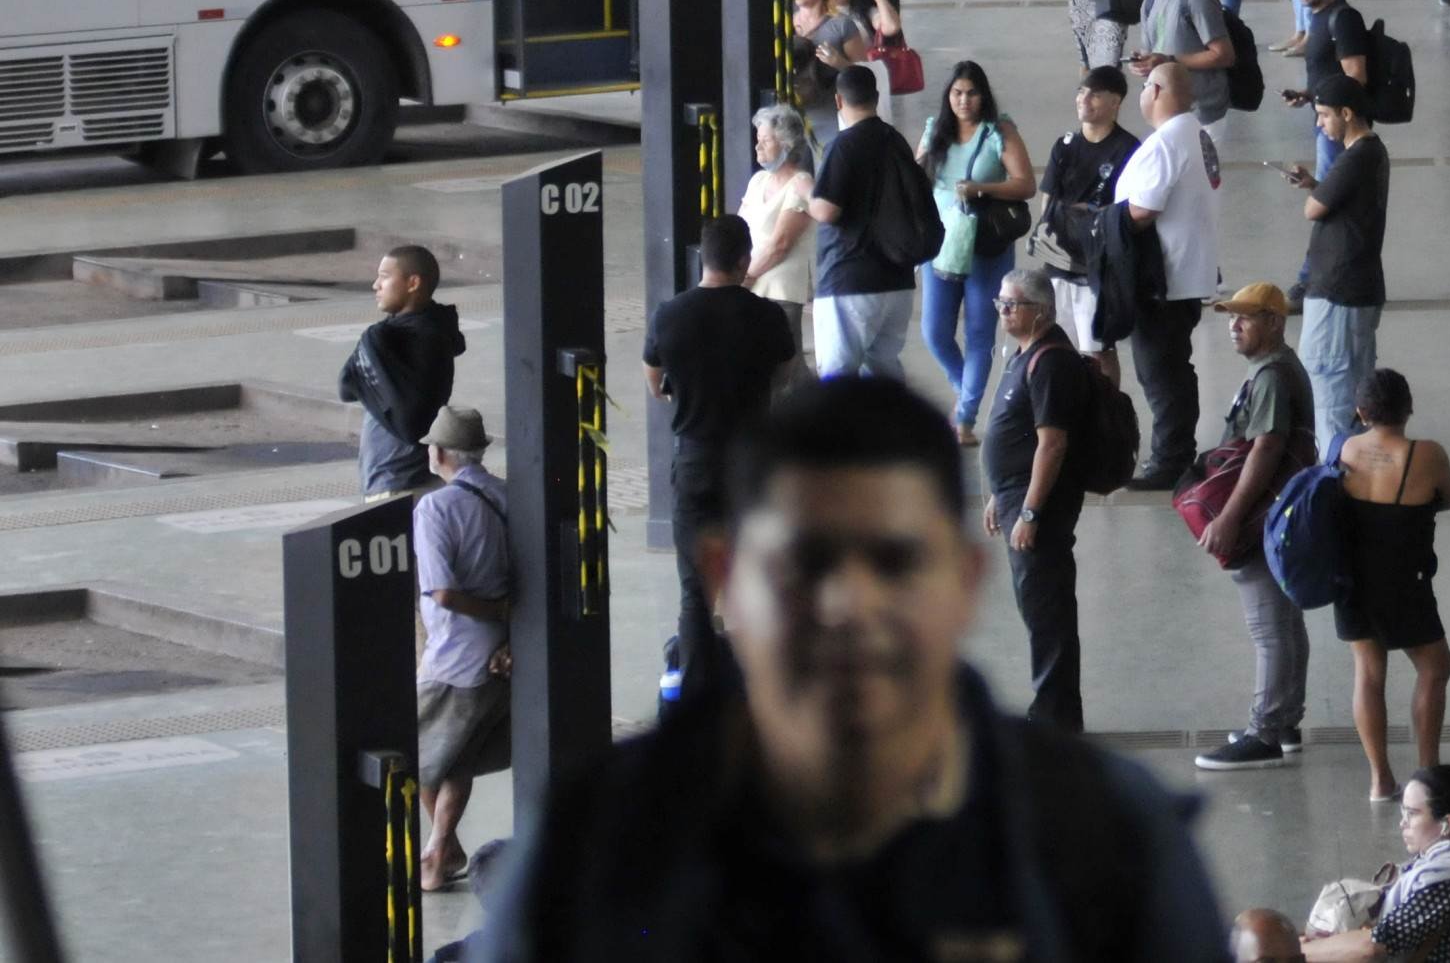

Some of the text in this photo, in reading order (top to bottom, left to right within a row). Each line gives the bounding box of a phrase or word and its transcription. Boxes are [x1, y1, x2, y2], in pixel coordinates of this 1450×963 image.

[541, 182, 599, 215] C 02
[339, 534, 408, 578] C 01
